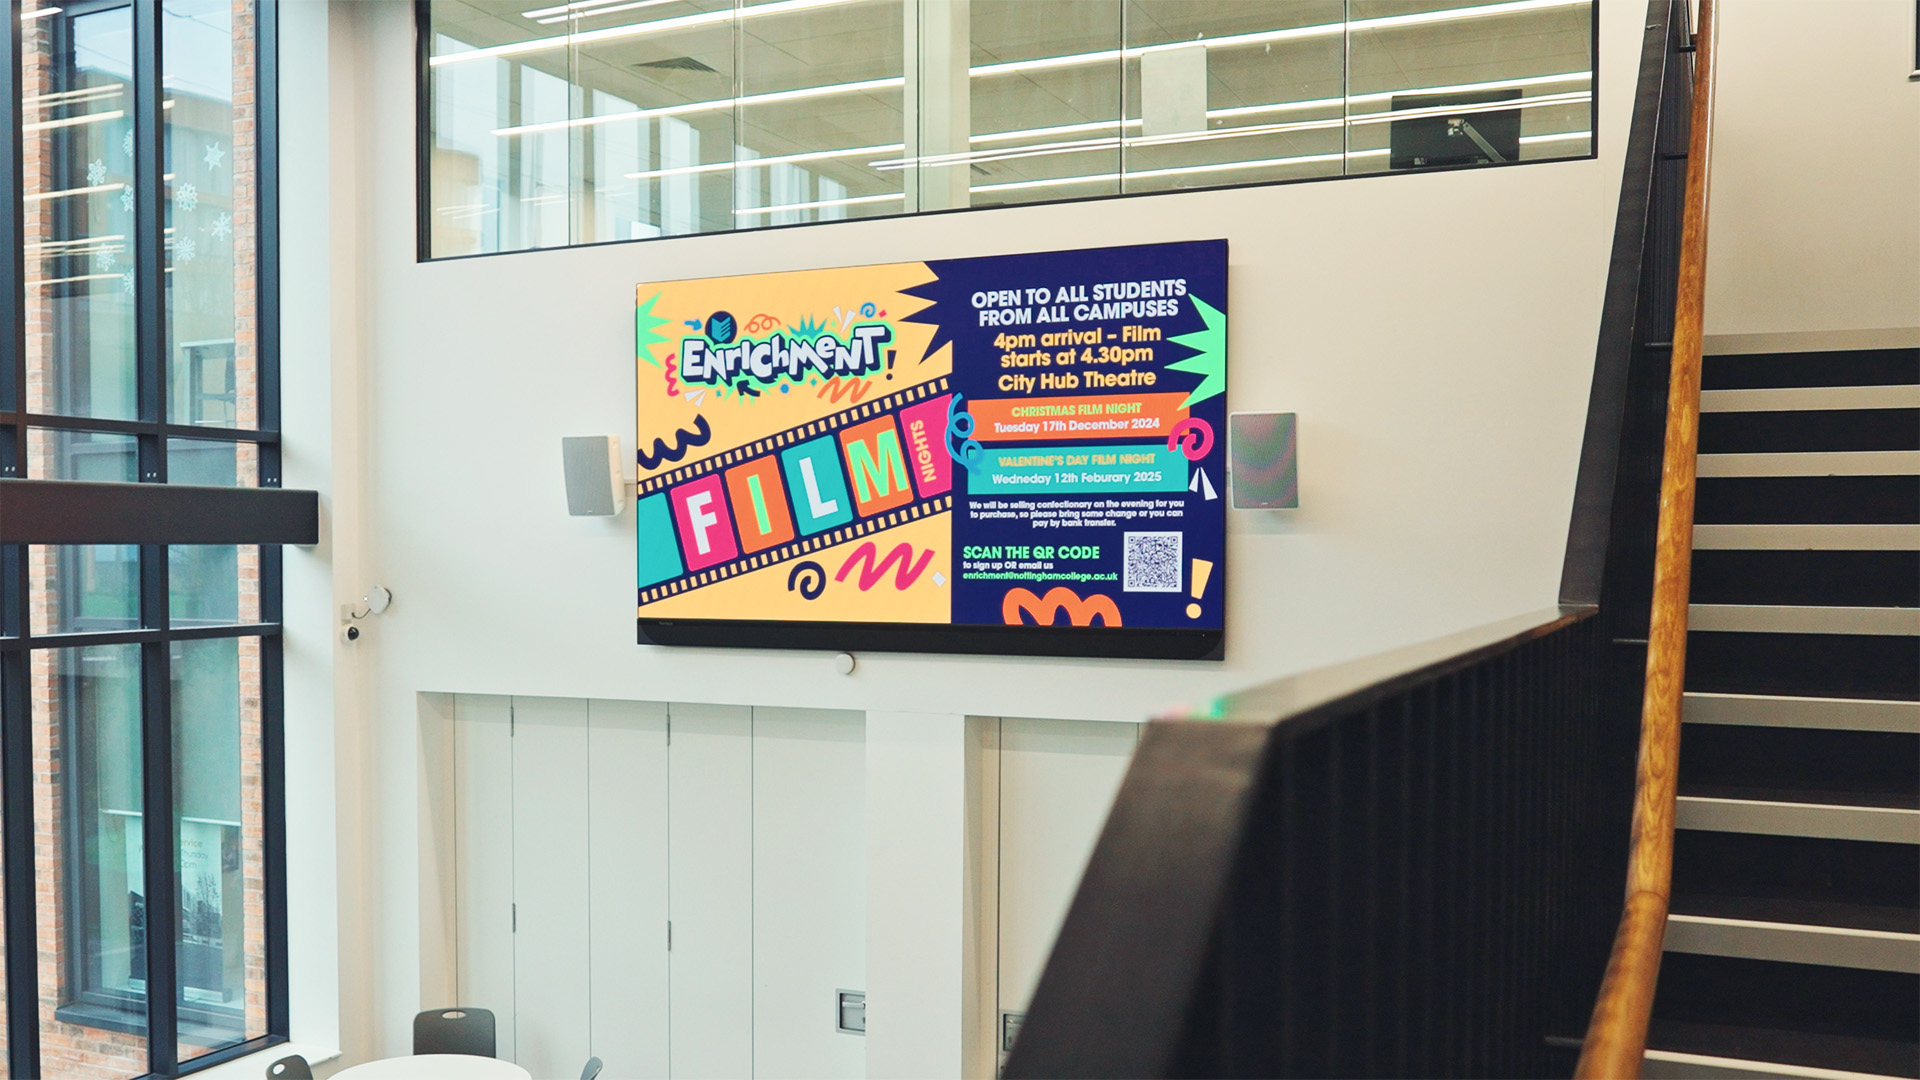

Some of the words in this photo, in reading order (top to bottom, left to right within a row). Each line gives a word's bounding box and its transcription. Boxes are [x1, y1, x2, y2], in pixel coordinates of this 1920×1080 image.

[972, 290, 1022, 308] OPEN
[1026, 287, 1051, 305] TO
[1055, 285, 1088, 304] ALL
[1093, 279, 1186, 301] STUDENTS
[979, 308, 1031, 327] FROM
[1036, 305, 1069, 323] ALL
[1074, 299, 1179, 321] CAMPUSES
[994, 333, 1036, 351] 4pm
[1041, 328, 1102, 346] arrival
[1122, 325, 1161, 342] Film
[1001, 350, 1051, 368] starts
[1056, 349, 1076, 365] at
[1081, 346, 1153, 367] 4.30pm
[998, 374, 1035, 393] City
[1041, 372, 1079, 389] Hub
[1083, 370, 1156, 387] Theatre
[1012, 406, 1075, 417] CHRISTMAS
[1078, 404, 1102, 415] FILM
[1106, 403, 1142, 414] NIGHT
[994, 422, 1040, 434] Tuesday
[1043, 420, 1066, 431] 17th
[1069, 419, 1129, 431] December
[1132, 418, 1160, 429] 2024
[910, 420, 937, 483] NIGHTS
[1066, 456, 1089, 466] DAY
[1091, 454, 1116, 465] FILM
[1119, 453, 1155, 464] NIGHT
[1055, 473, 1078, 483] 12th
[1081, 472, 1130, 485] Feburary
[1134, 471, 1162, 482] 2025
[686, 429, 908, 555] FILM
[969, 501, 982, 509] We
[983, 501, 996, 509] will
[998, 501, 1008, 509] be
[1010, 501, 1035, 510] selling
[1037, 500, 1092, 510] confectionary
[1106, 500, 1120, 508] the
[1121, 499, 1154, 509] evening
[1156, 499, 1167, 507] for
[1169, 501, 1184, 509] you
[979, 510, 1018, 520] purchase,
[1030, 510, 1057, 519] please
[1059, 510, 1080, 519] bring
[1105, 509, 1137, 519] change
[1149, 510, 1164, 518] you
[1032, 520, 1048, 528] pay
[1050, 519, 1060, 528] by
[1061, 519, 1083, 527] bank
[1084, 519, 1117, 527] transfer.
[963, 546, 1002, 559] SCAN
[1005, 546, 1030, 559] THE
[1033, 546, 1054, 559] QR
[1058, 546, 1100, 559] CODE
[973, 561, 989, 571] sign
[991, 562, 1003, 571] up
[1004, 561, 1017, 569] OR
[1018, 561, 1042, 569] email
[962, 571, 1119, 582] enrichment@nottinghamcollege.ac.uk
